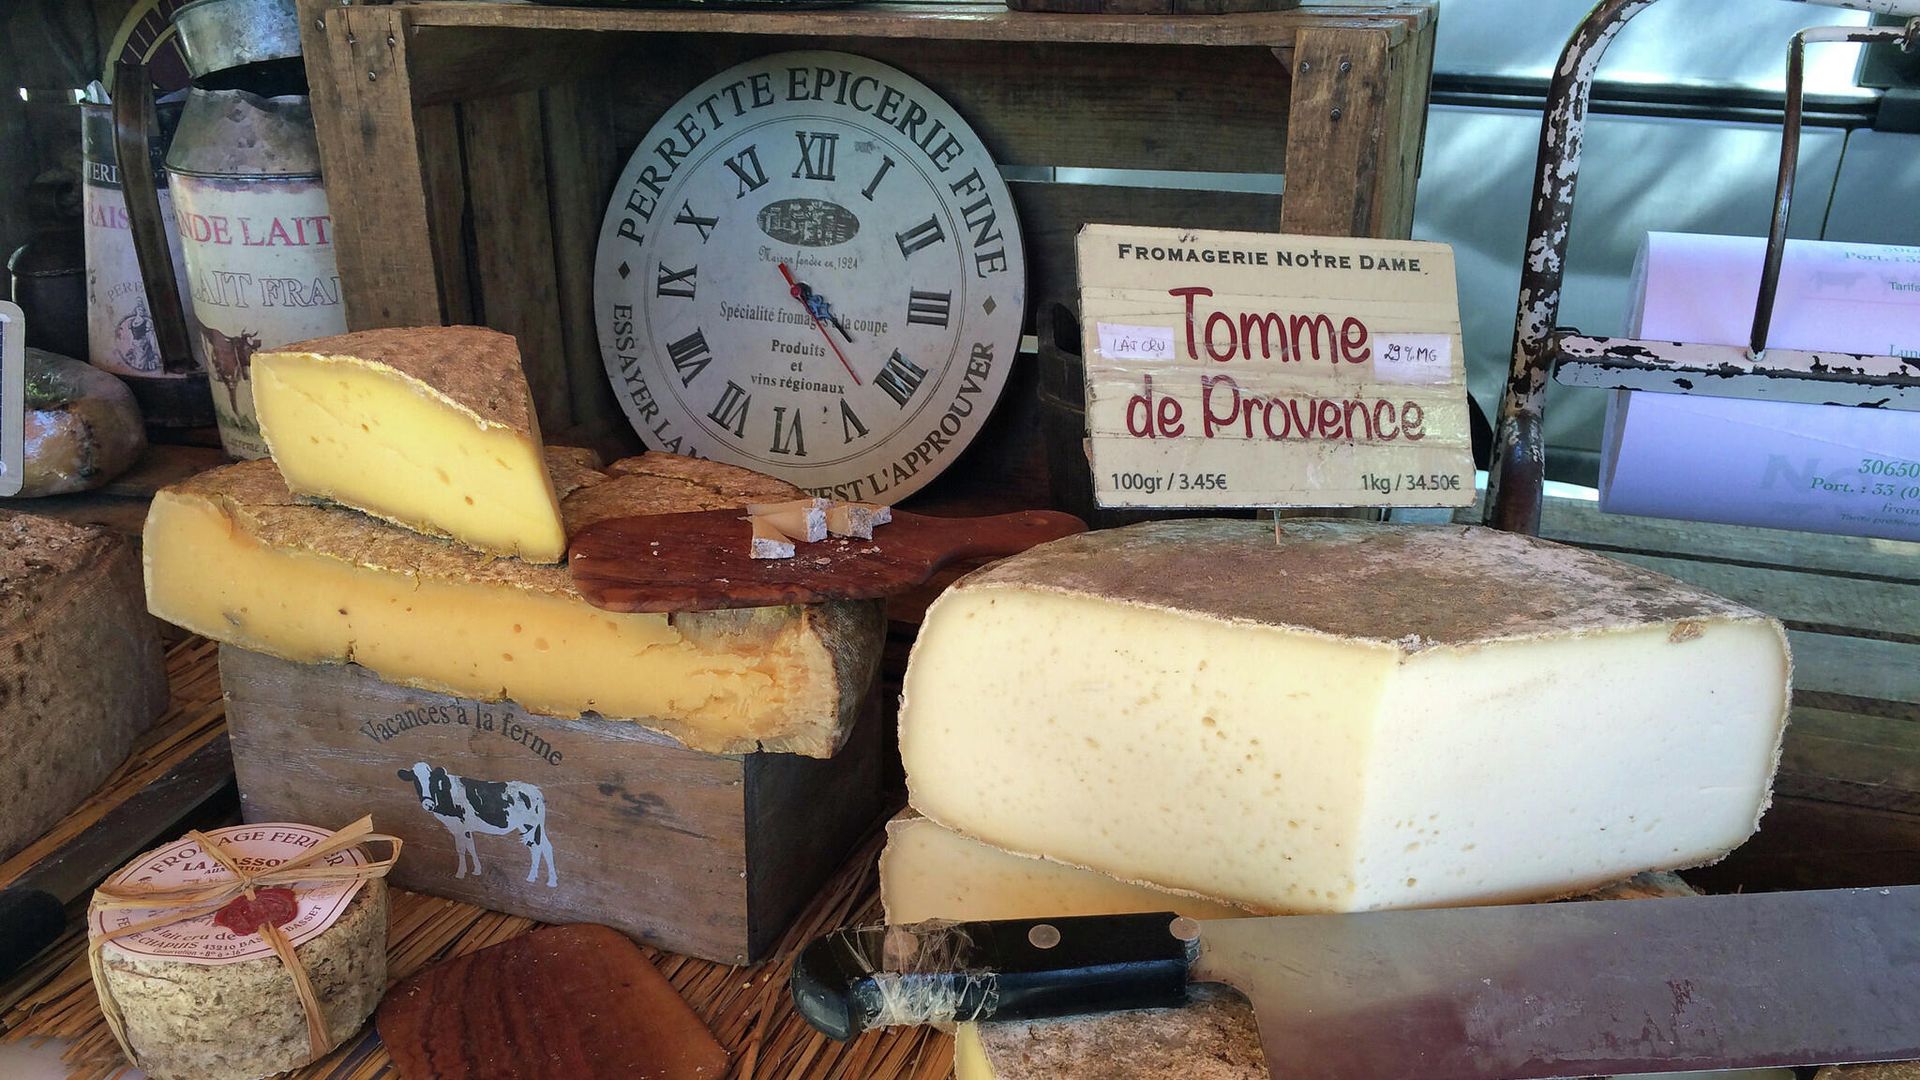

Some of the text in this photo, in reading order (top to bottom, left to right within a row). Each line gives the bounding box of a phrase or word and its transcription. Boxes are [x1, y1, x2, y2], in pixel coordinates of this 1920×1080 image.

[616, 67, 1008, 279] PERRETTE EPICERIE FINE
[792, 130, 840, 181] XII
[242, 215, 331, 247] LAIT
[674, 199, 720, 244] X
[1118, 243, 1268, 266] FROMAGERIE
[1359, 255, 1421, 272] DAME
[853, 318, 888, 337] coupe
[1168, 286, 1371, 364] Tomme
[613, 303, 660, 424] ESSAYER
[771, 339, 826, 357] Produits
[790, 359, 803, 372] et
[751, 372, 845, 395] vins régionaux
[868, 342, 995, 496] L'APPROUVER
[1126, 374, 1427, 441] de Provence
[1111, 472, 1163, 493] 100gr
[1178, 473, 1228, 491] 3.45€
[1361, 474, 1392, 494] 1kg
[1405, 475, 1461, 492] 34.50€
[1811, 477, 1855, 493] Port.
[359, 702, 450, 744] Vacances
[476, 702, 493, 731] la
[501, 712, 563, 766] ferme
[150, 831, 265, 874] FROAGE
